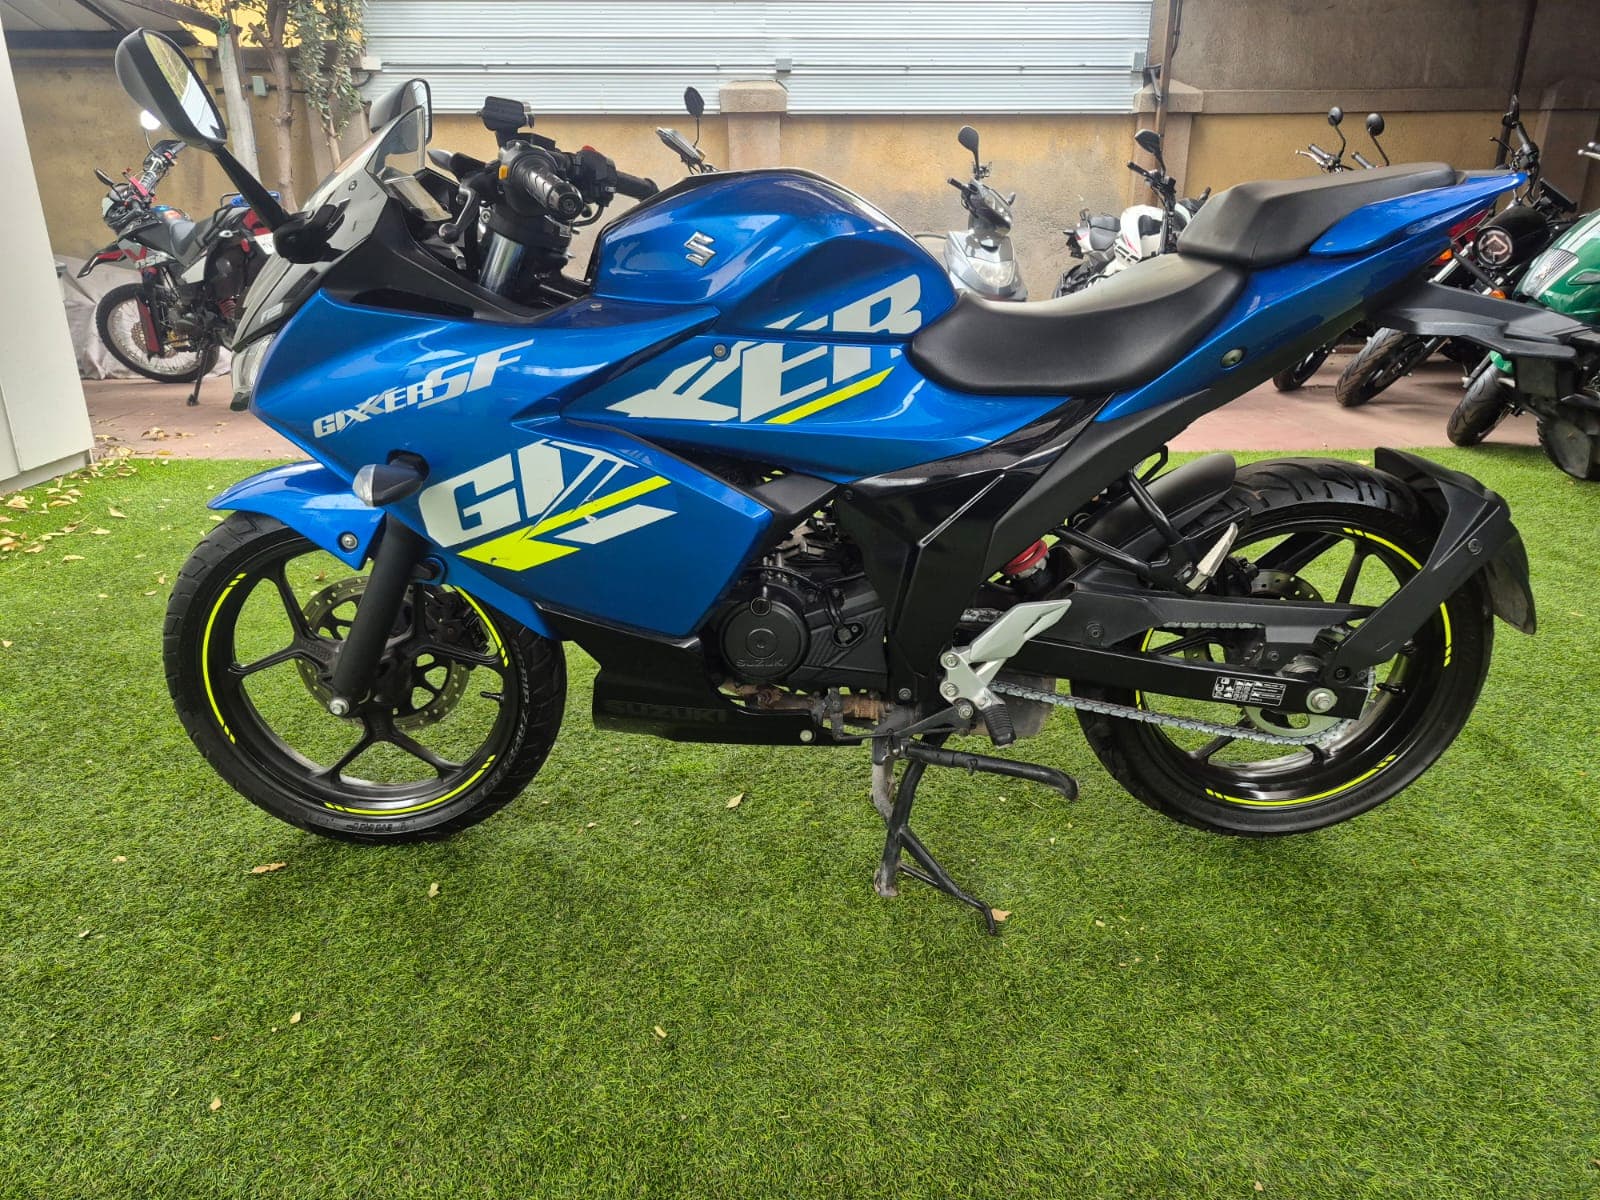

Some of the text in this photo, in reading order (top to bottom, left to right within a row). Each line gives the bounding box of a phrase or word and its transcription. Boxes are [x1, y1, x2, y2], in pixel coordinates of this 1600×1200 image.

[313, 339, 535, 438] GIXXER SF
[603, 700, 727, 723] SUZUKI
